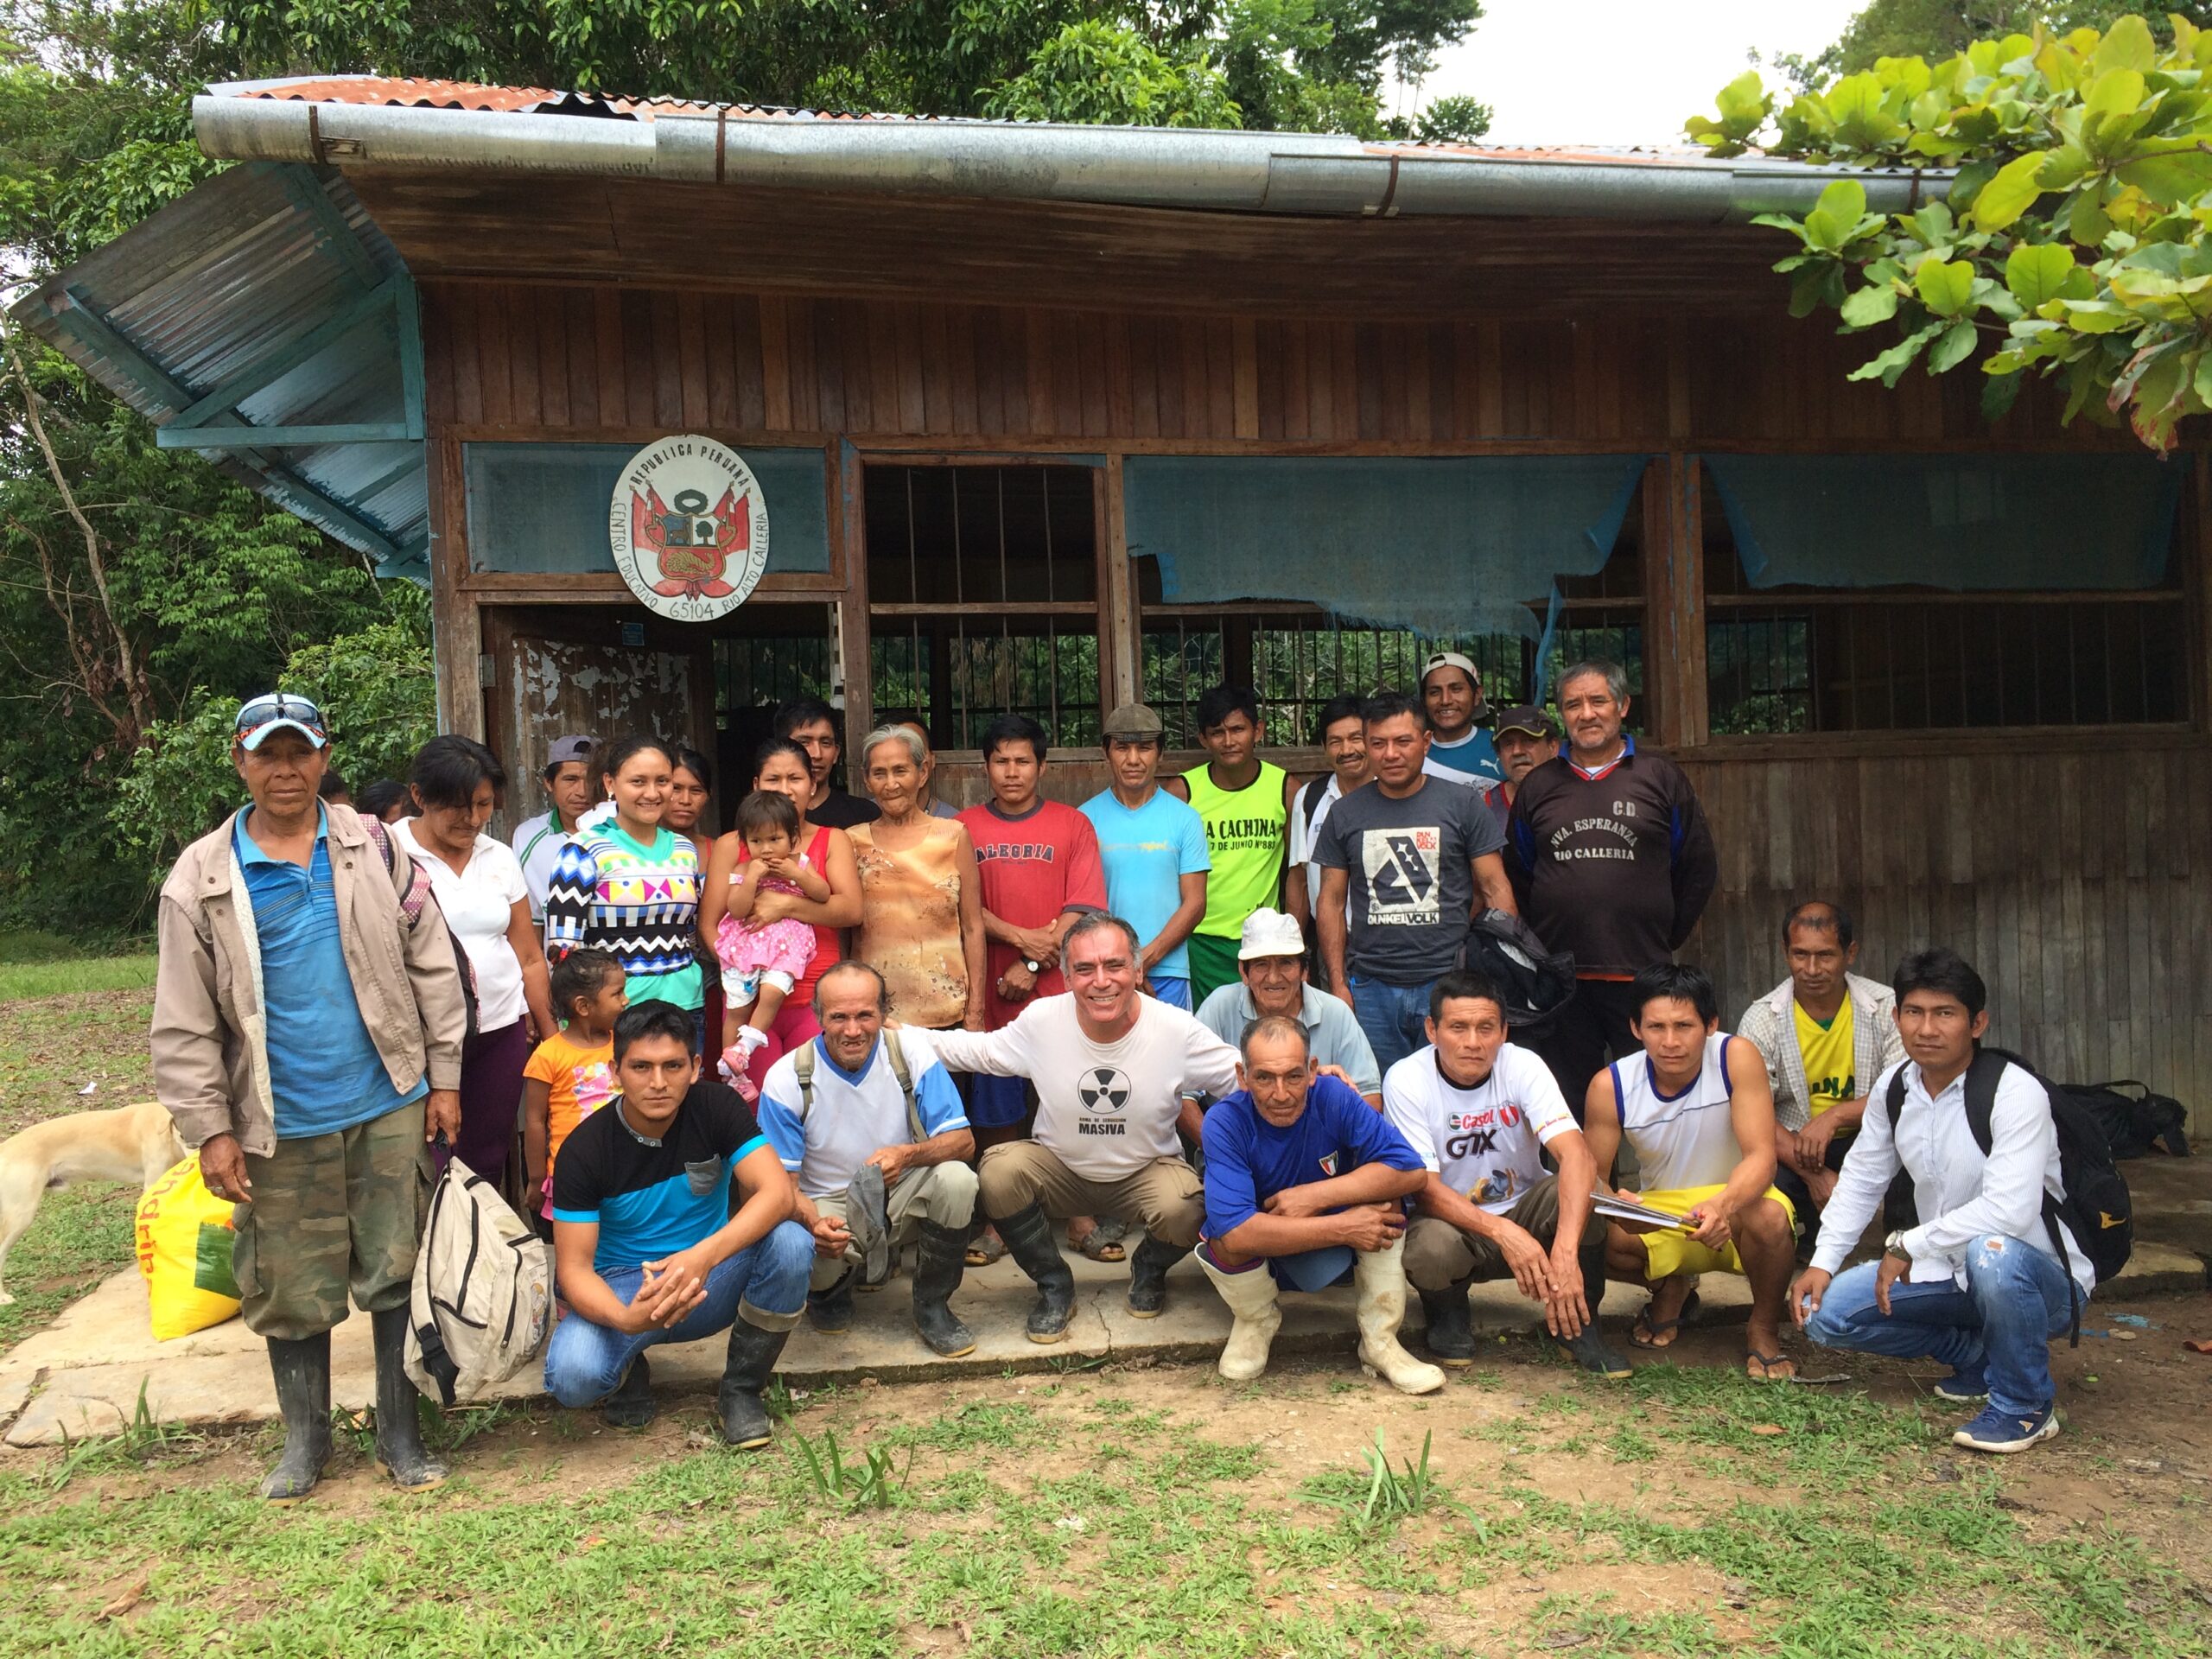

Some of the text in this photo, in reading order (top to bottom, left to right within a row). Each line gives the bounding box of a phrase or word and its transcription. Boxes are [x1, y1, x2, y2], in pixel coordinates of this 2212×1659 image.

[630, 443, 749, 486] REPUBLICA PERUANA
[611, 503, 768, 620] CENTRO EDUCATIVO 65104 RIO ALTO CALLERIA
[1219, 818, 1276, 839] CACHINA
[1550, 817, 1638, 848] NVA. ESPERANZA
[975, 843, 1054, 864] ALEGRIA
[1218, 842, 1228, 851] DE
[1230, 840, 1254, 850] JUNIO
[1554, 848, 1635, 861] RIO CALLERIA
[1078, 1123, 1126, 1135] MASIVA
[1446, 1128, 1497, 1160] GTX
